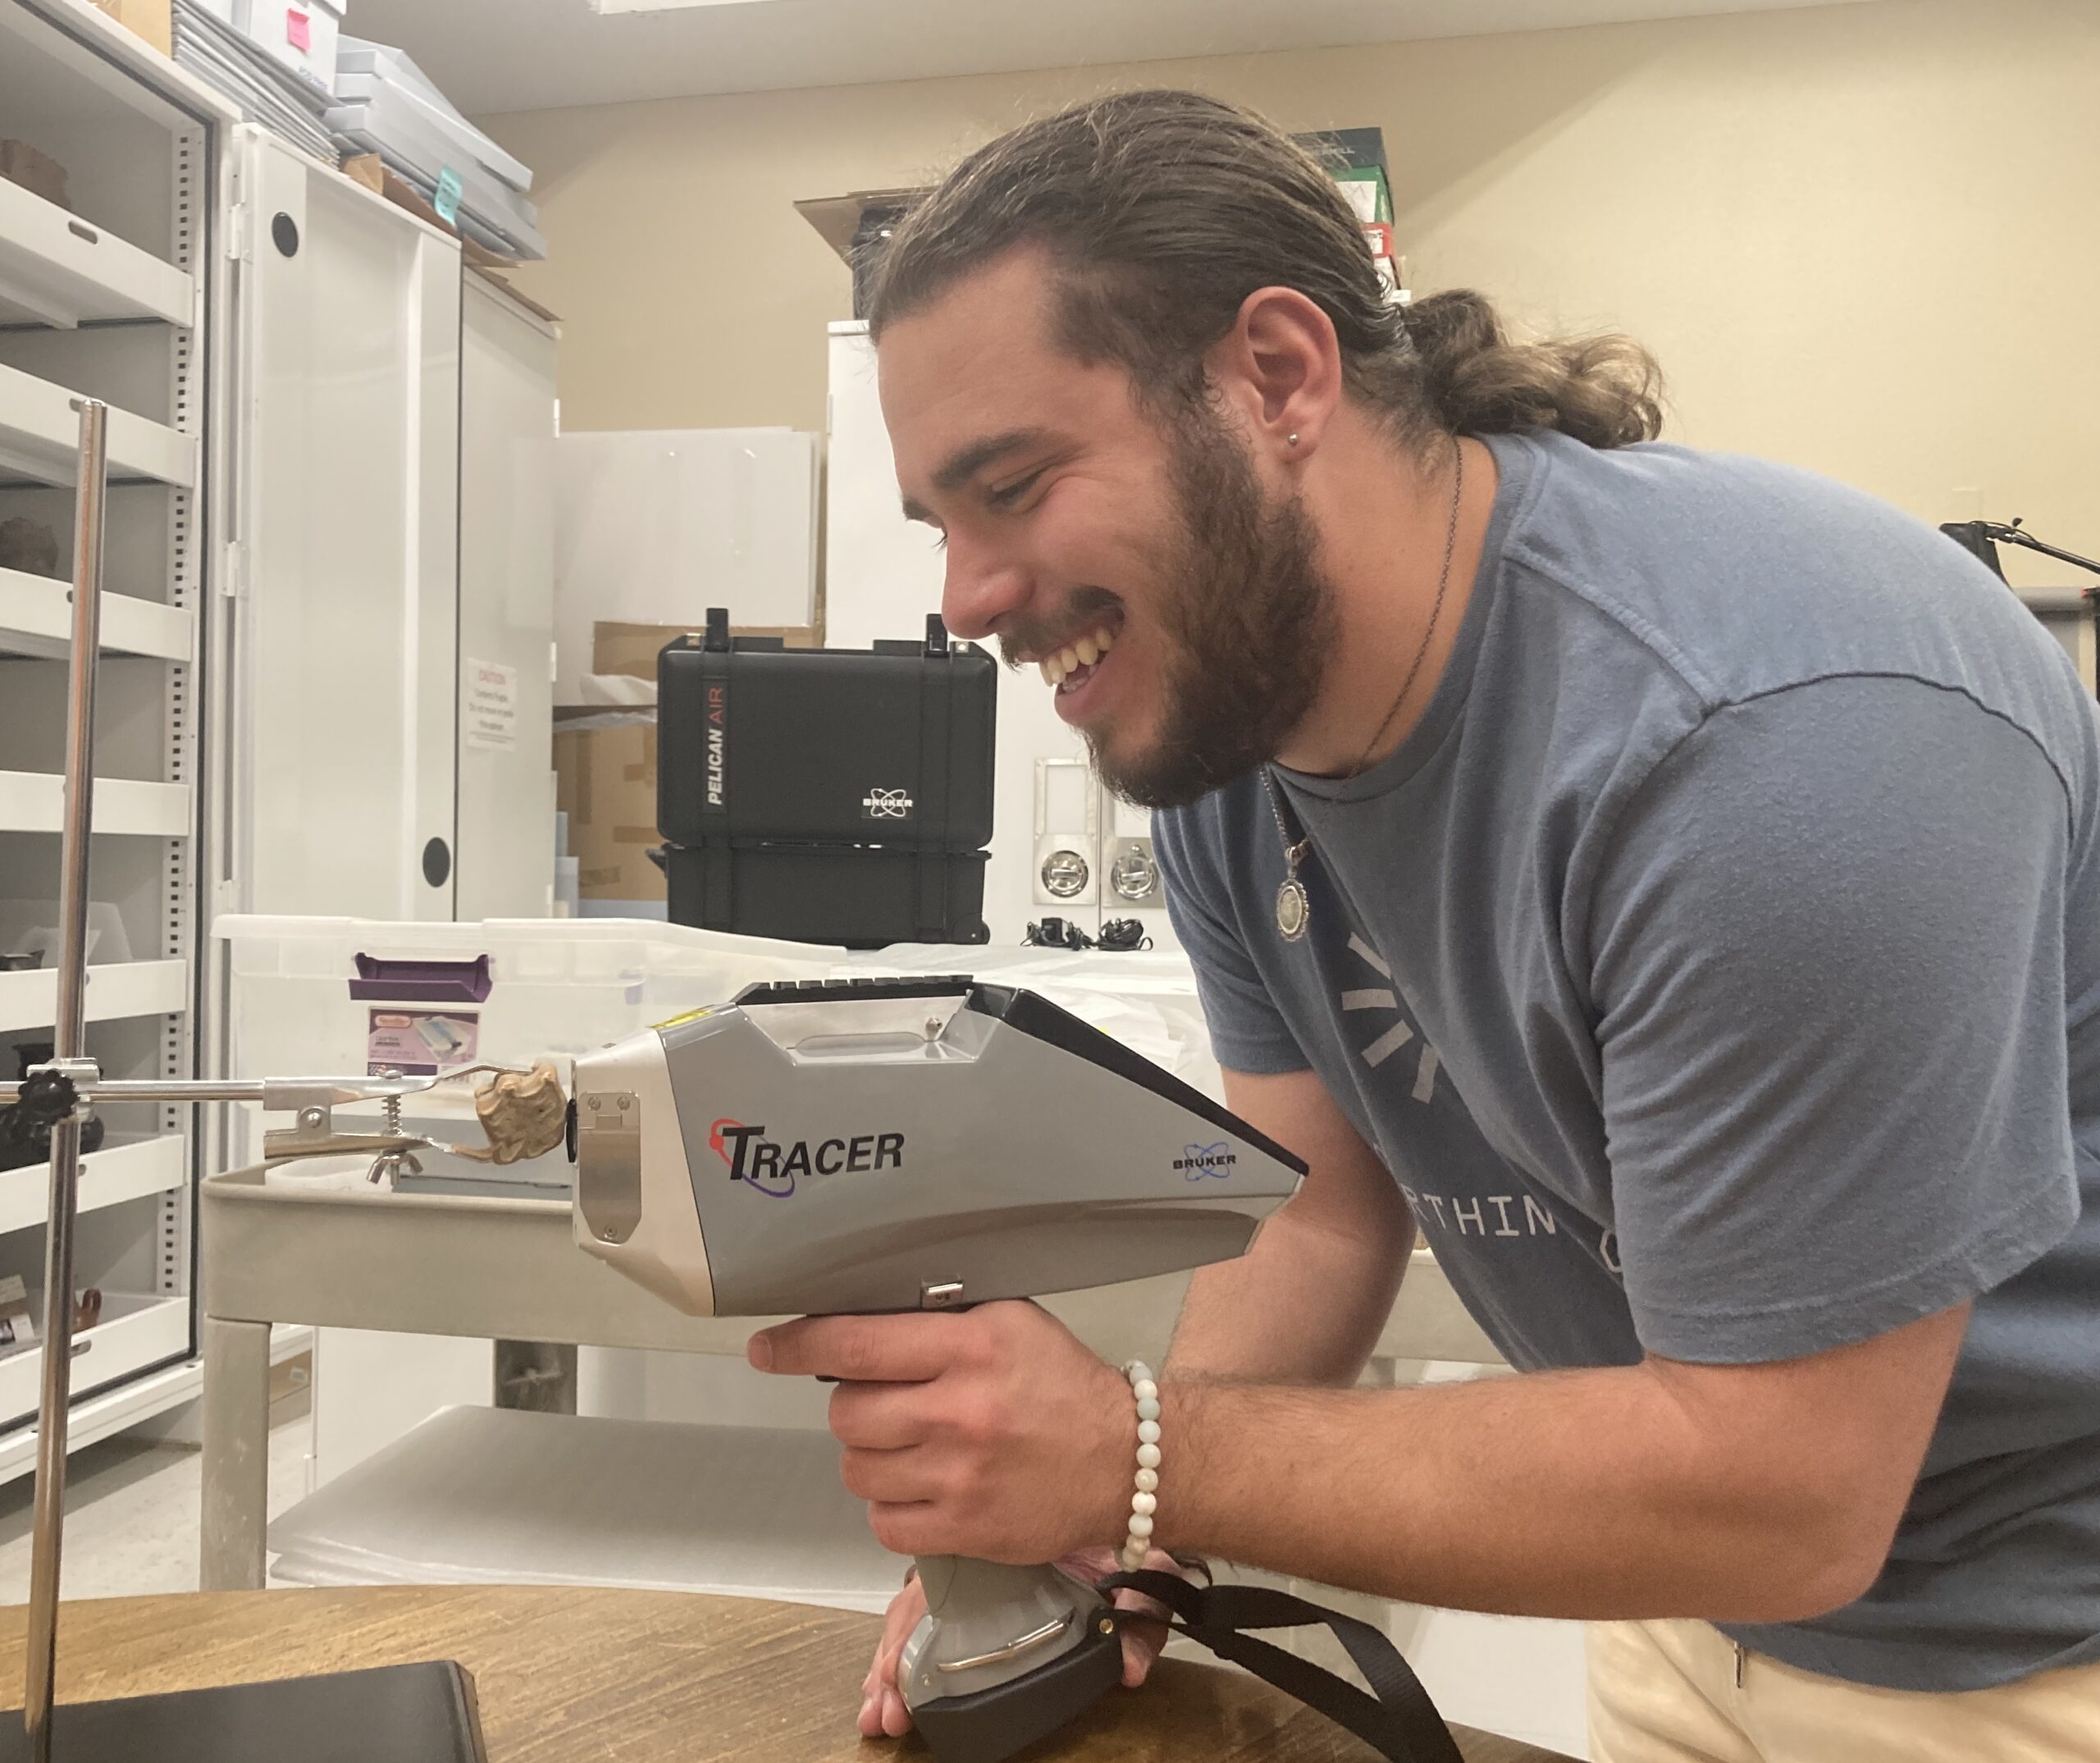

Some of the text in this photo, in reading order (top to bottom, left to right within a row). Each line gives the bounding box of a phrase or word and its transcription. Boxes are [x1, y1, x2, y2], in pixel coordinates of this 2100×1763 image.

[708, 687, 724, 805] PELICAN AIR
[863, 797, 913, 807] BRUKER
[1172, 1154, 1236, 1169] BRUKER
